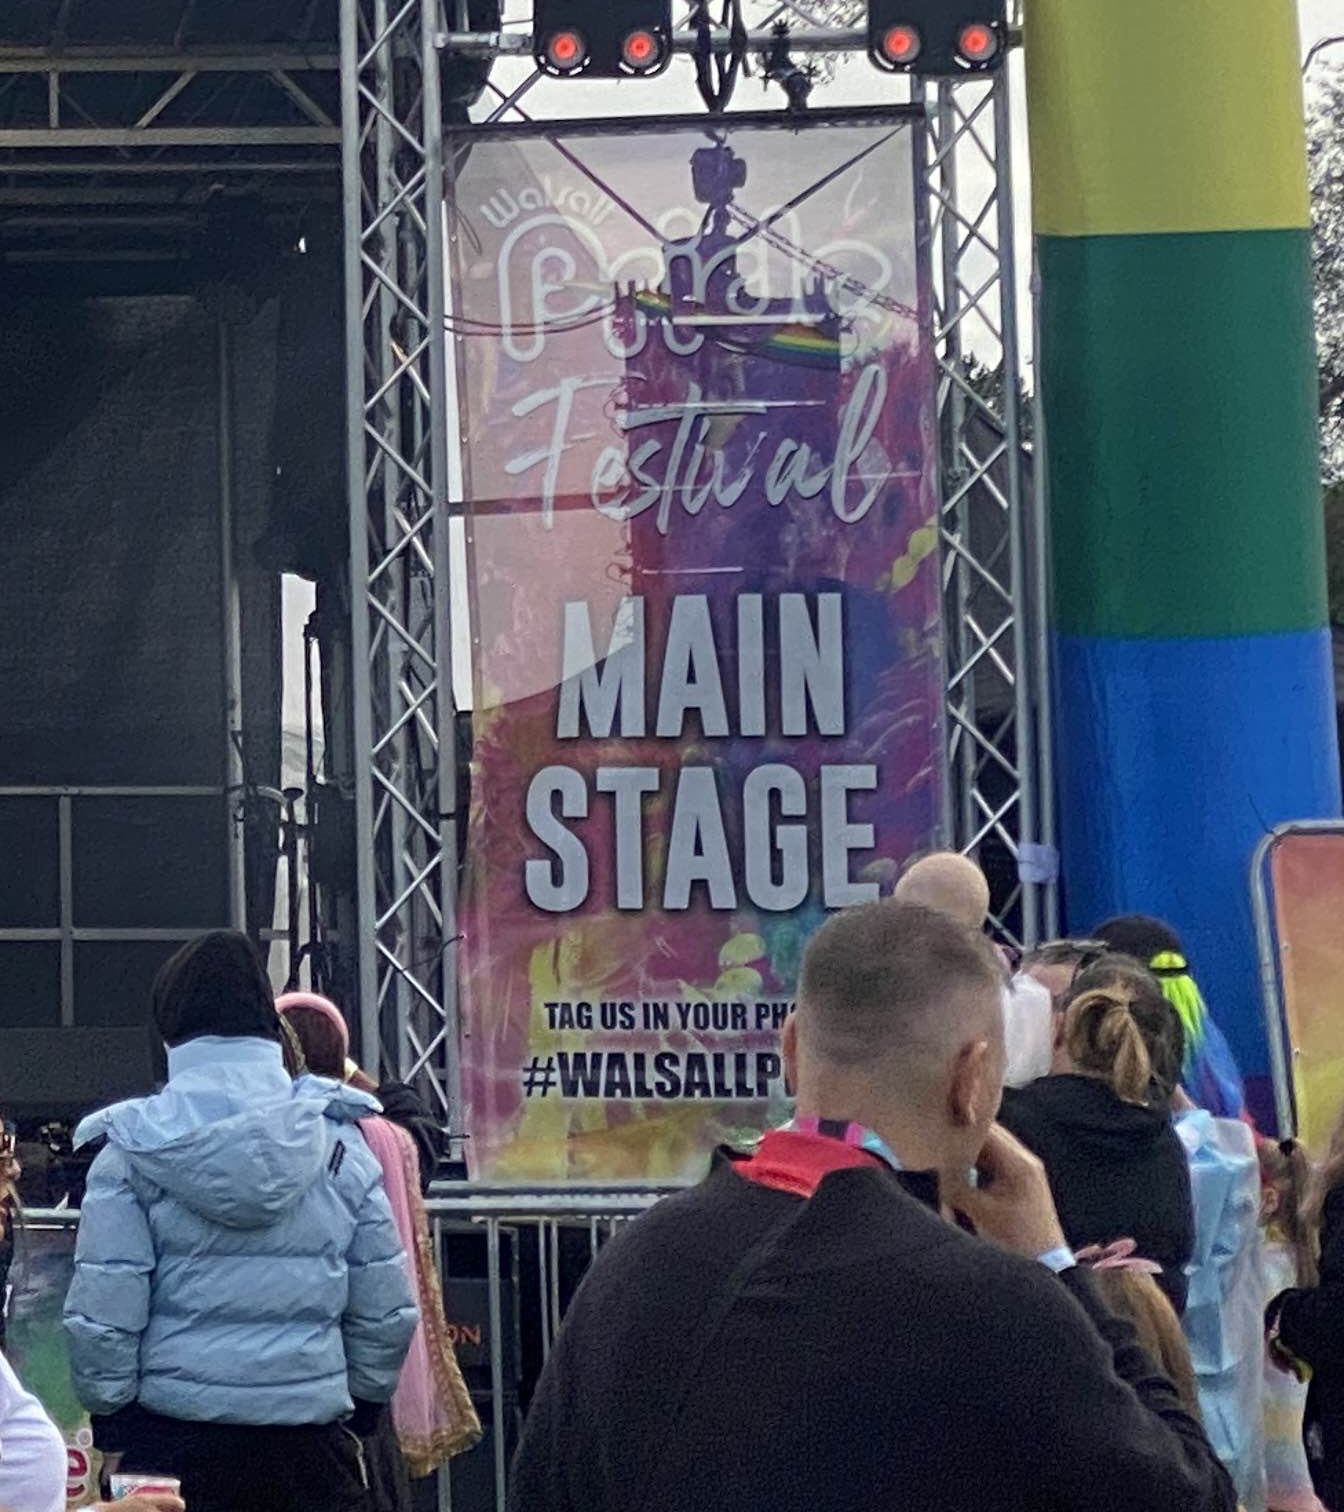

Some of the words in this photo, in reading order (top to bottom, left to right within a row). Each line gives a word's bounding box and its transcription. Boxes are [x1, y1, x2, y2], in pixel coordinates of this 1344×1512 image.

[480, 176, 612, 229] Walsall
[499, 206, 892, 362] Pride
[505, 364, 888, 535] Festival
[557, 593, 845, 738] MAIN
[525, 764, 879, 912] STAGE
[523, 1051, 797, 1098] #WALSALLP
[544, 1002, 593, 1030] TAG
[600, 1002, 635, 1030] US
[643, 1002, 669, 1030] IN
[676, 1002, 747, 1030] YOUR
